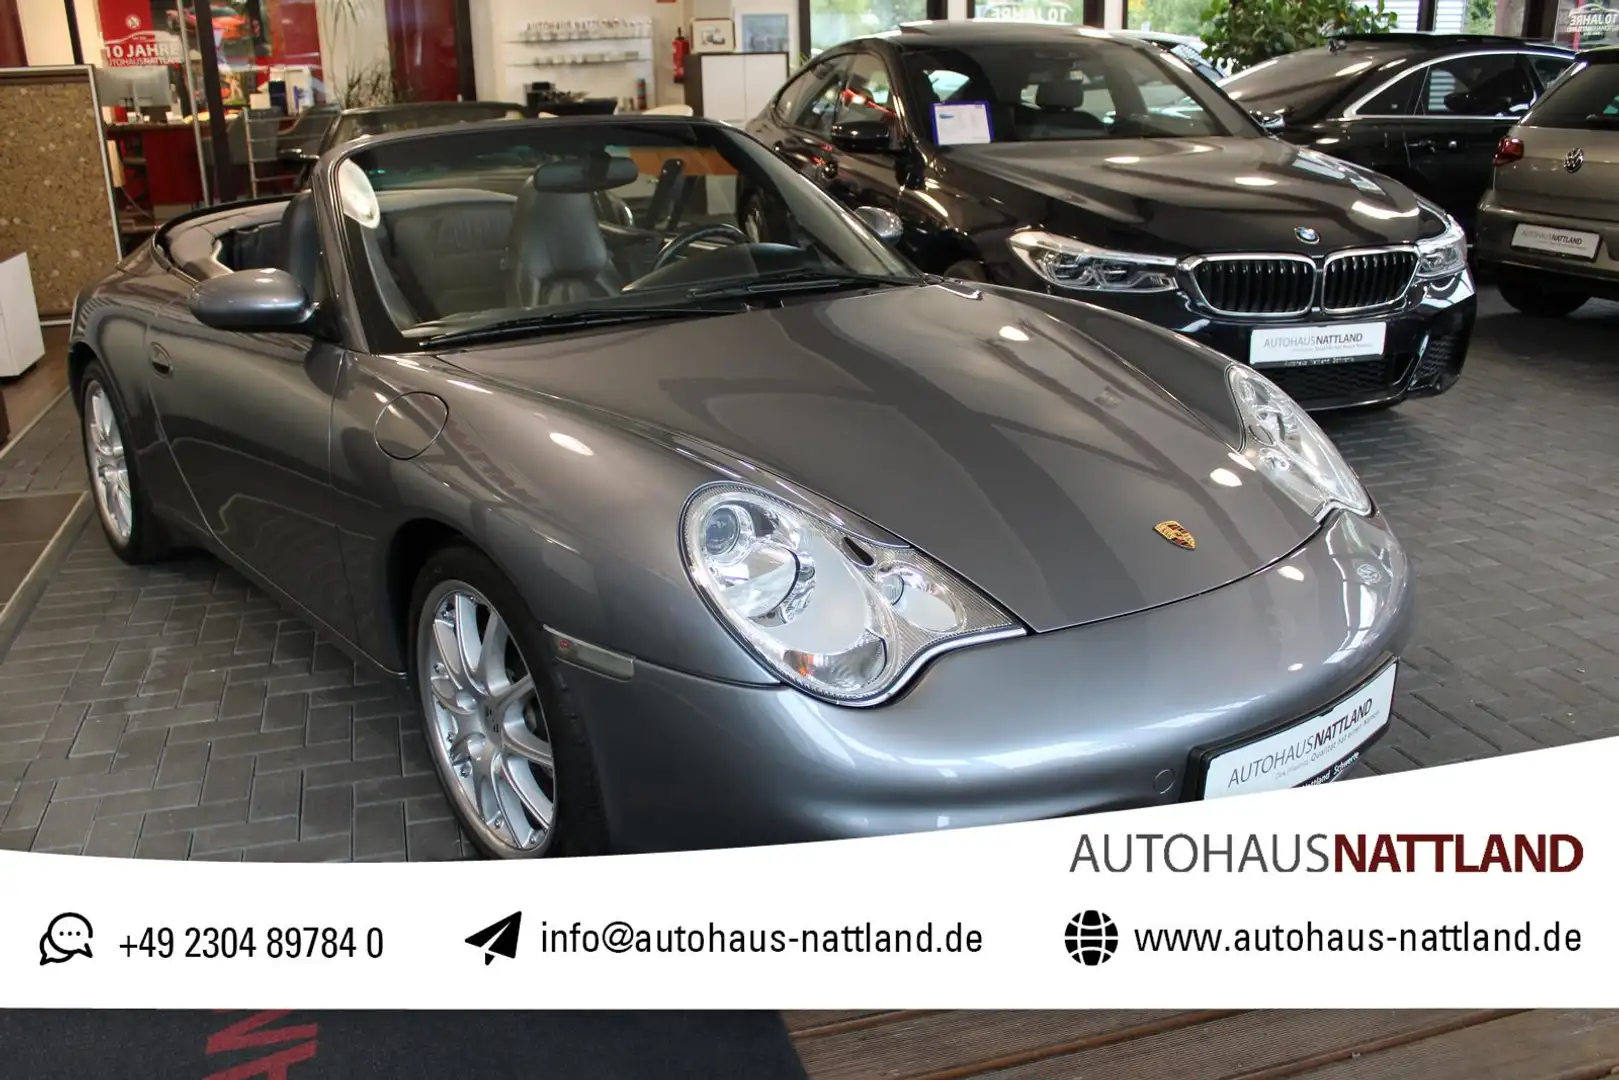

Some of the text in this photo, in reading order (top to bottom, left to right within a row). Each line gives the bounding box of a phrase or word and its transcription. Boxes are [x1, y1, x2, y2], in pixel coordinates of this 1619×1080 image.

[105, 43, 179, 58] 10 JAHRE
[1263, 332, 1363, 349] AUTOHAUSNATTLAND
[1228, 698, 1373, 788] AUTOHAUSNATTLAND
